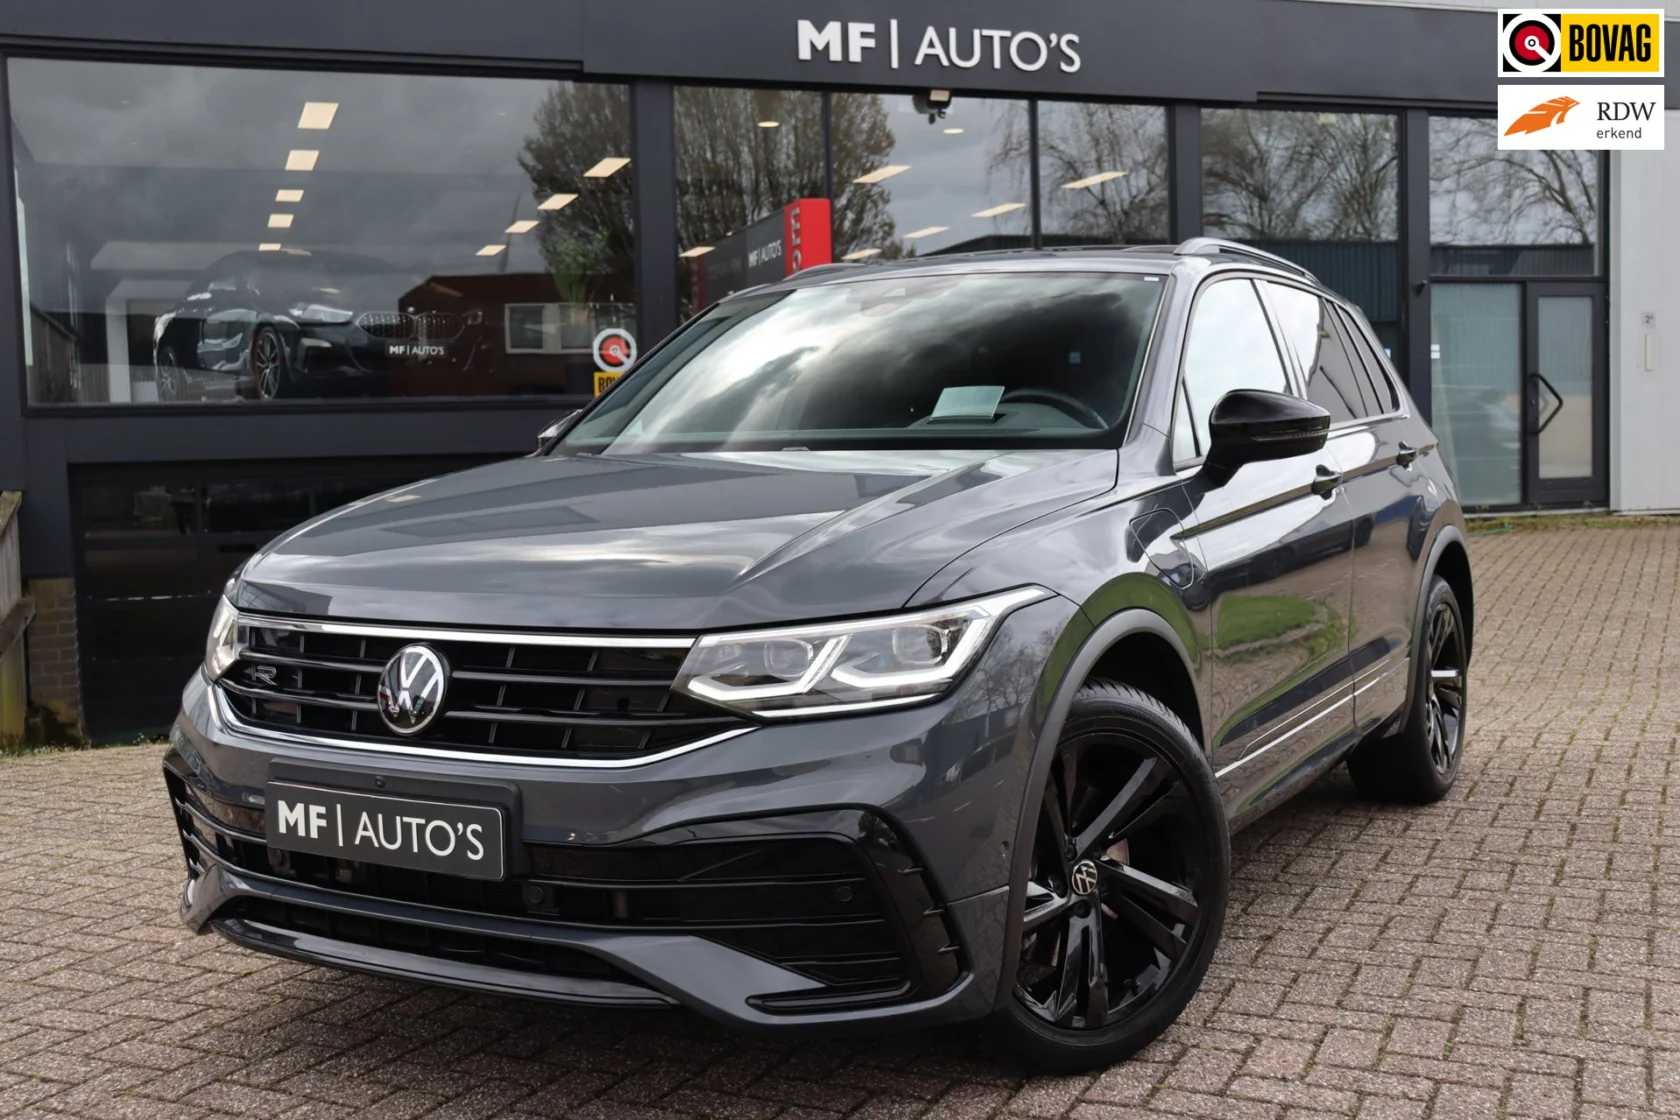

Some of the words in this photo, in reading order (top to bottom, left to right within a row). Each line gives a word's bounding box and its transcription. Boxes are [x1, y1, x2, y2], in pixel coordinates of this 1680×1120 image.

[797, 19, 876, 62] MF
[914, 26, 1081, 73] AUTO'S
[278, 800, 327, 838] MF
[354, 811, 485, 861] AUTO'S
